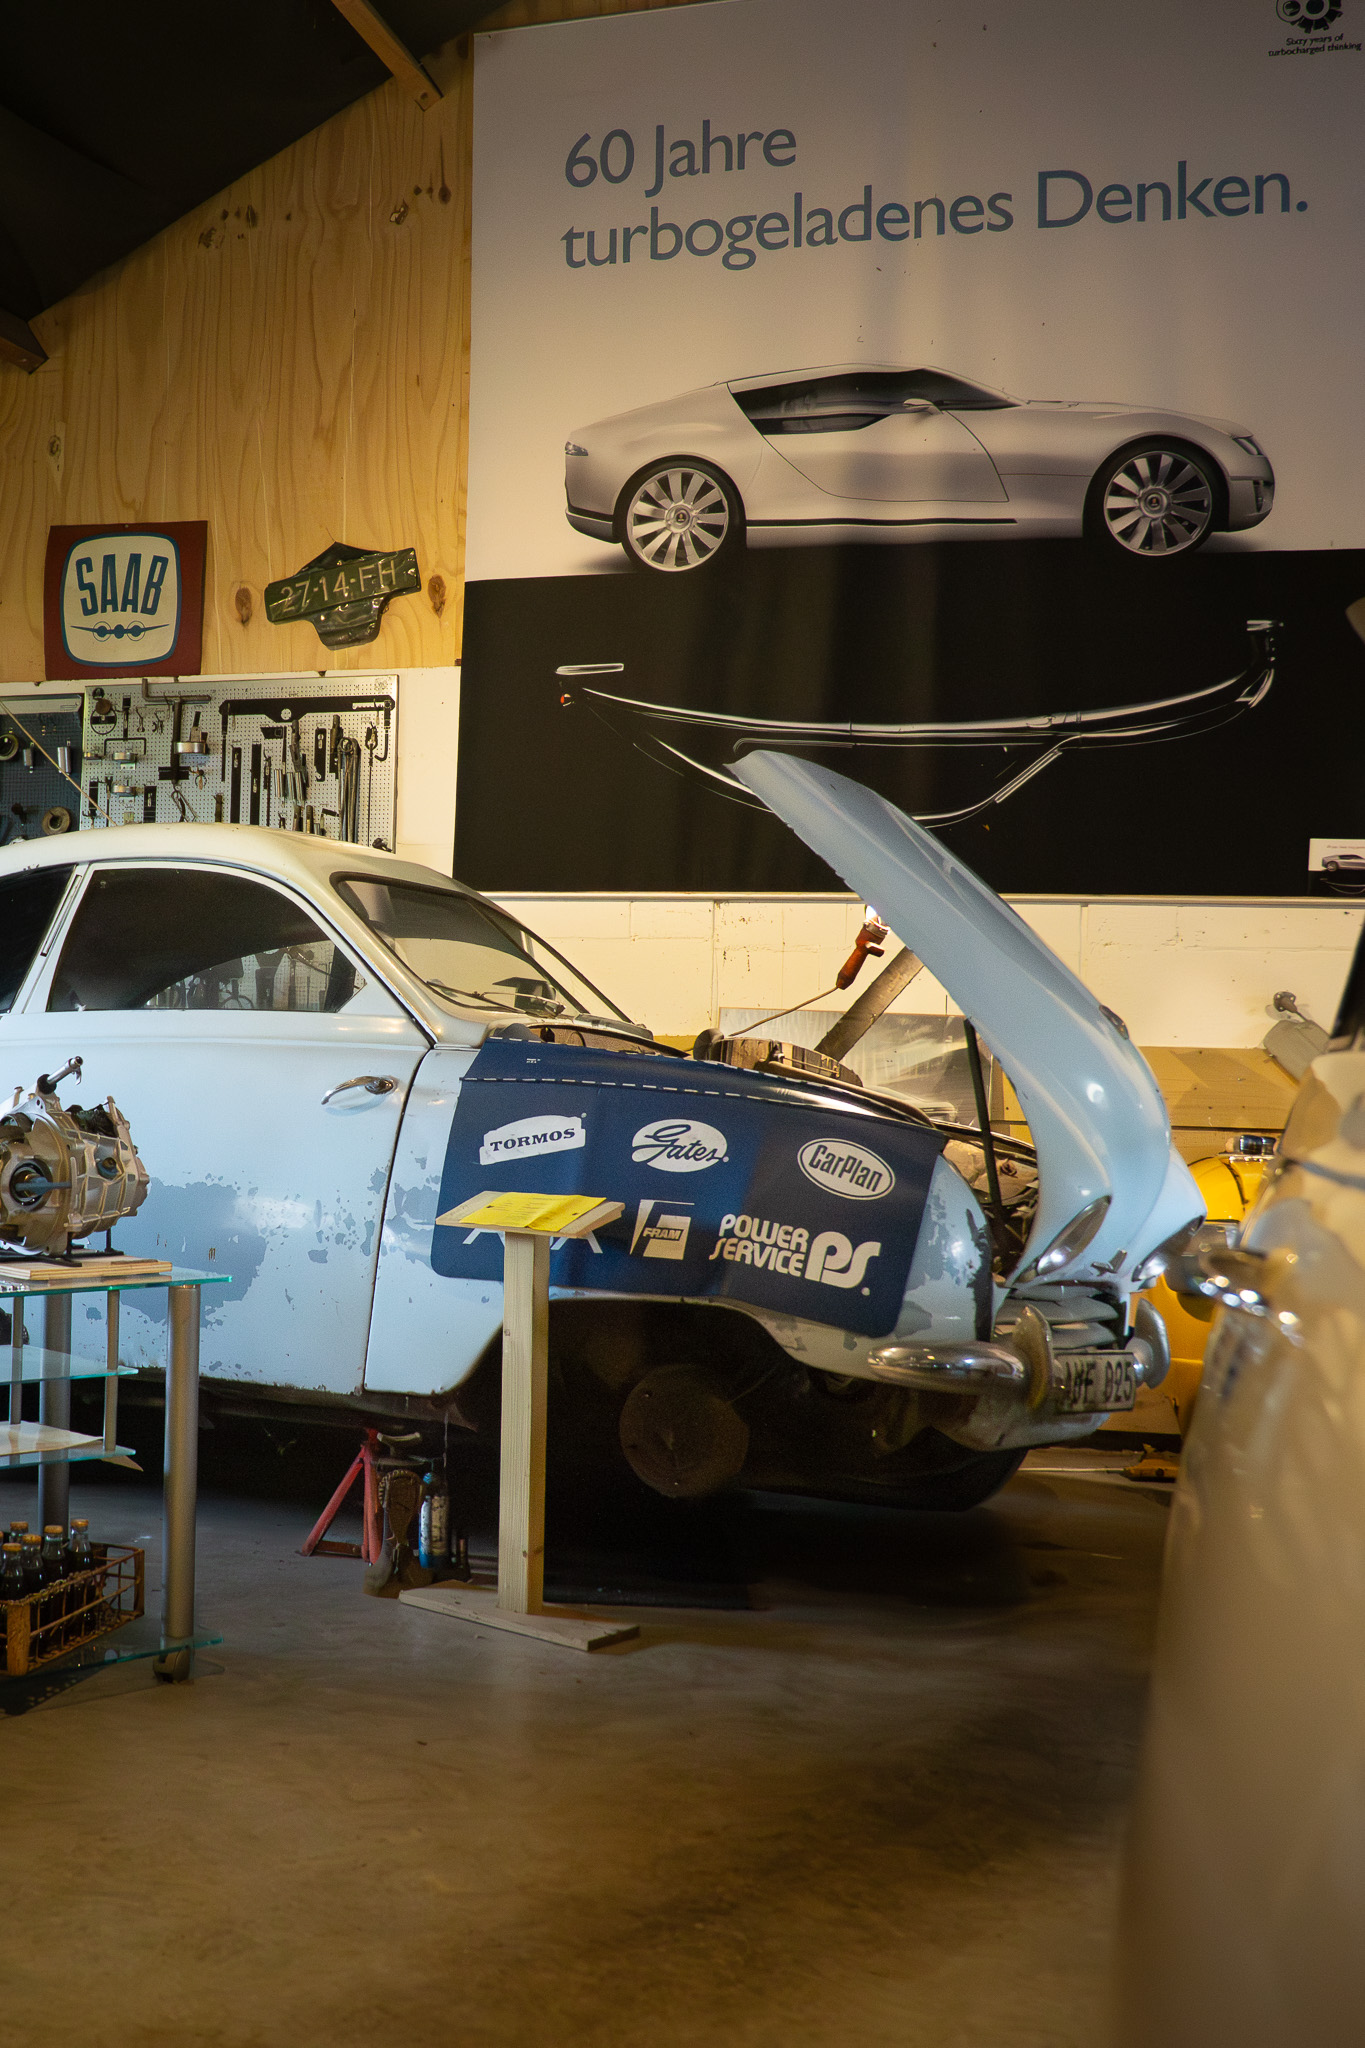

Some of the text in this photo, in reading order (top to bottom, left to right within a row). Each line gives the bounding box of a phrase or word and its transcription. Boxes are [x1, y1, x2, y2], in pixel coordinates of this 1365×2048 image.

[1268, 42, 1362, 57] turbocharged thinking
[1308, 35, 1333, 46] years
[1334, 33, 1344, 41] of
[565, 119, 797, 198] 60 Jahre
[560, 160, 1309, 271] turbogeladenes Denken.
[75, 553, 169, 616] SAAB
[280, 559, 396, 612] 27-14-FH
[490, 1128, 575, 1152] TORMOS
[642, 1124, 726, 1164] Gates
[808, 1144, 883, 1192] CarPlan
[642, 1227, 685, 1241] FRAM
[718, 1213, 810, 1253] POWER
[708, 1238, 806, 1277] SERVICE
